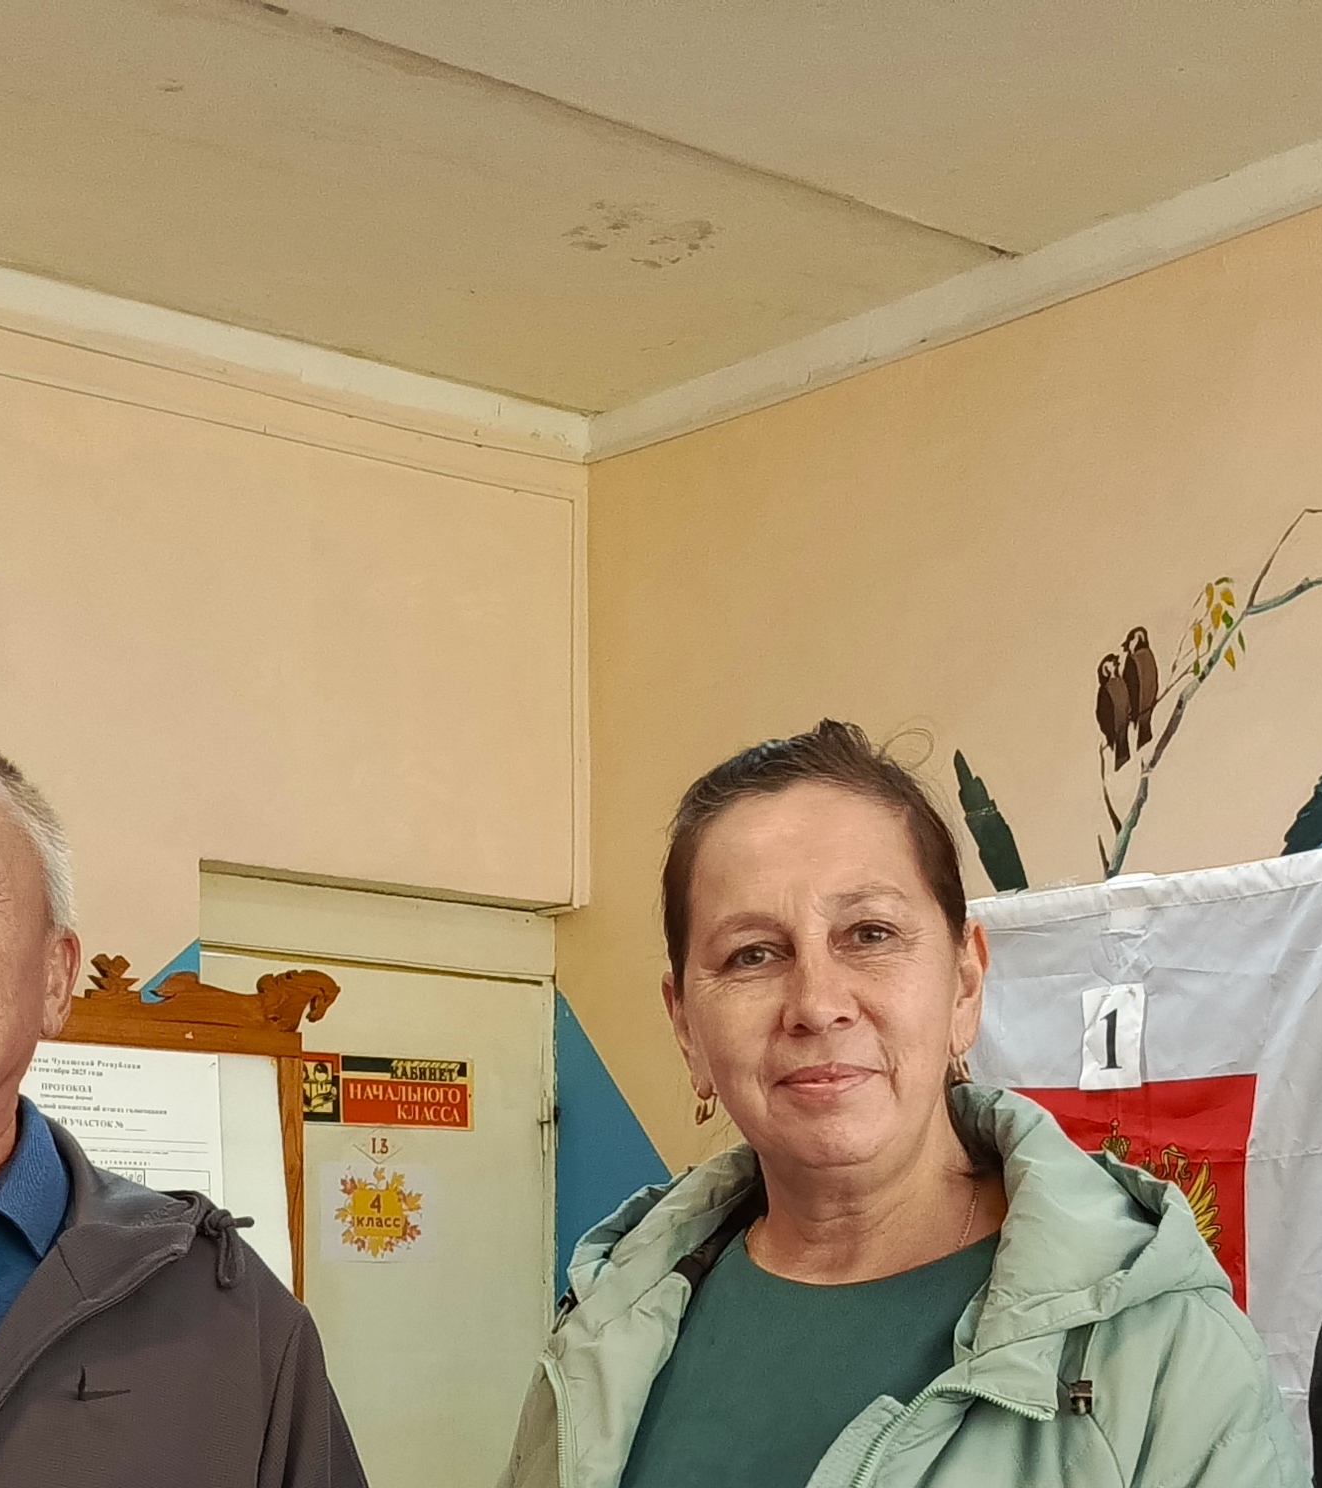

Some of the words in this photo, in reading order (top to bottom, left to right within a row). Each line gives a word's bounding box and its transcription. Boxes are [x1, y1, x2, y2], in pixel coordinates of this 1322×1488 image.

[1099, 1008, 1122, 1072] 1
[390, 1064, 456, 1082] КАБИНЕТ
[40, 1082, 93, 1094] ПРОТОКОЛ
[348, 1082, 461, 1104] НАЧАЛЬНОГО
[397, 1104, 461, 1123] КЛАССА
[369, 1193, 382, 1214] 4
[356, 1216, 401, 1228] класс
